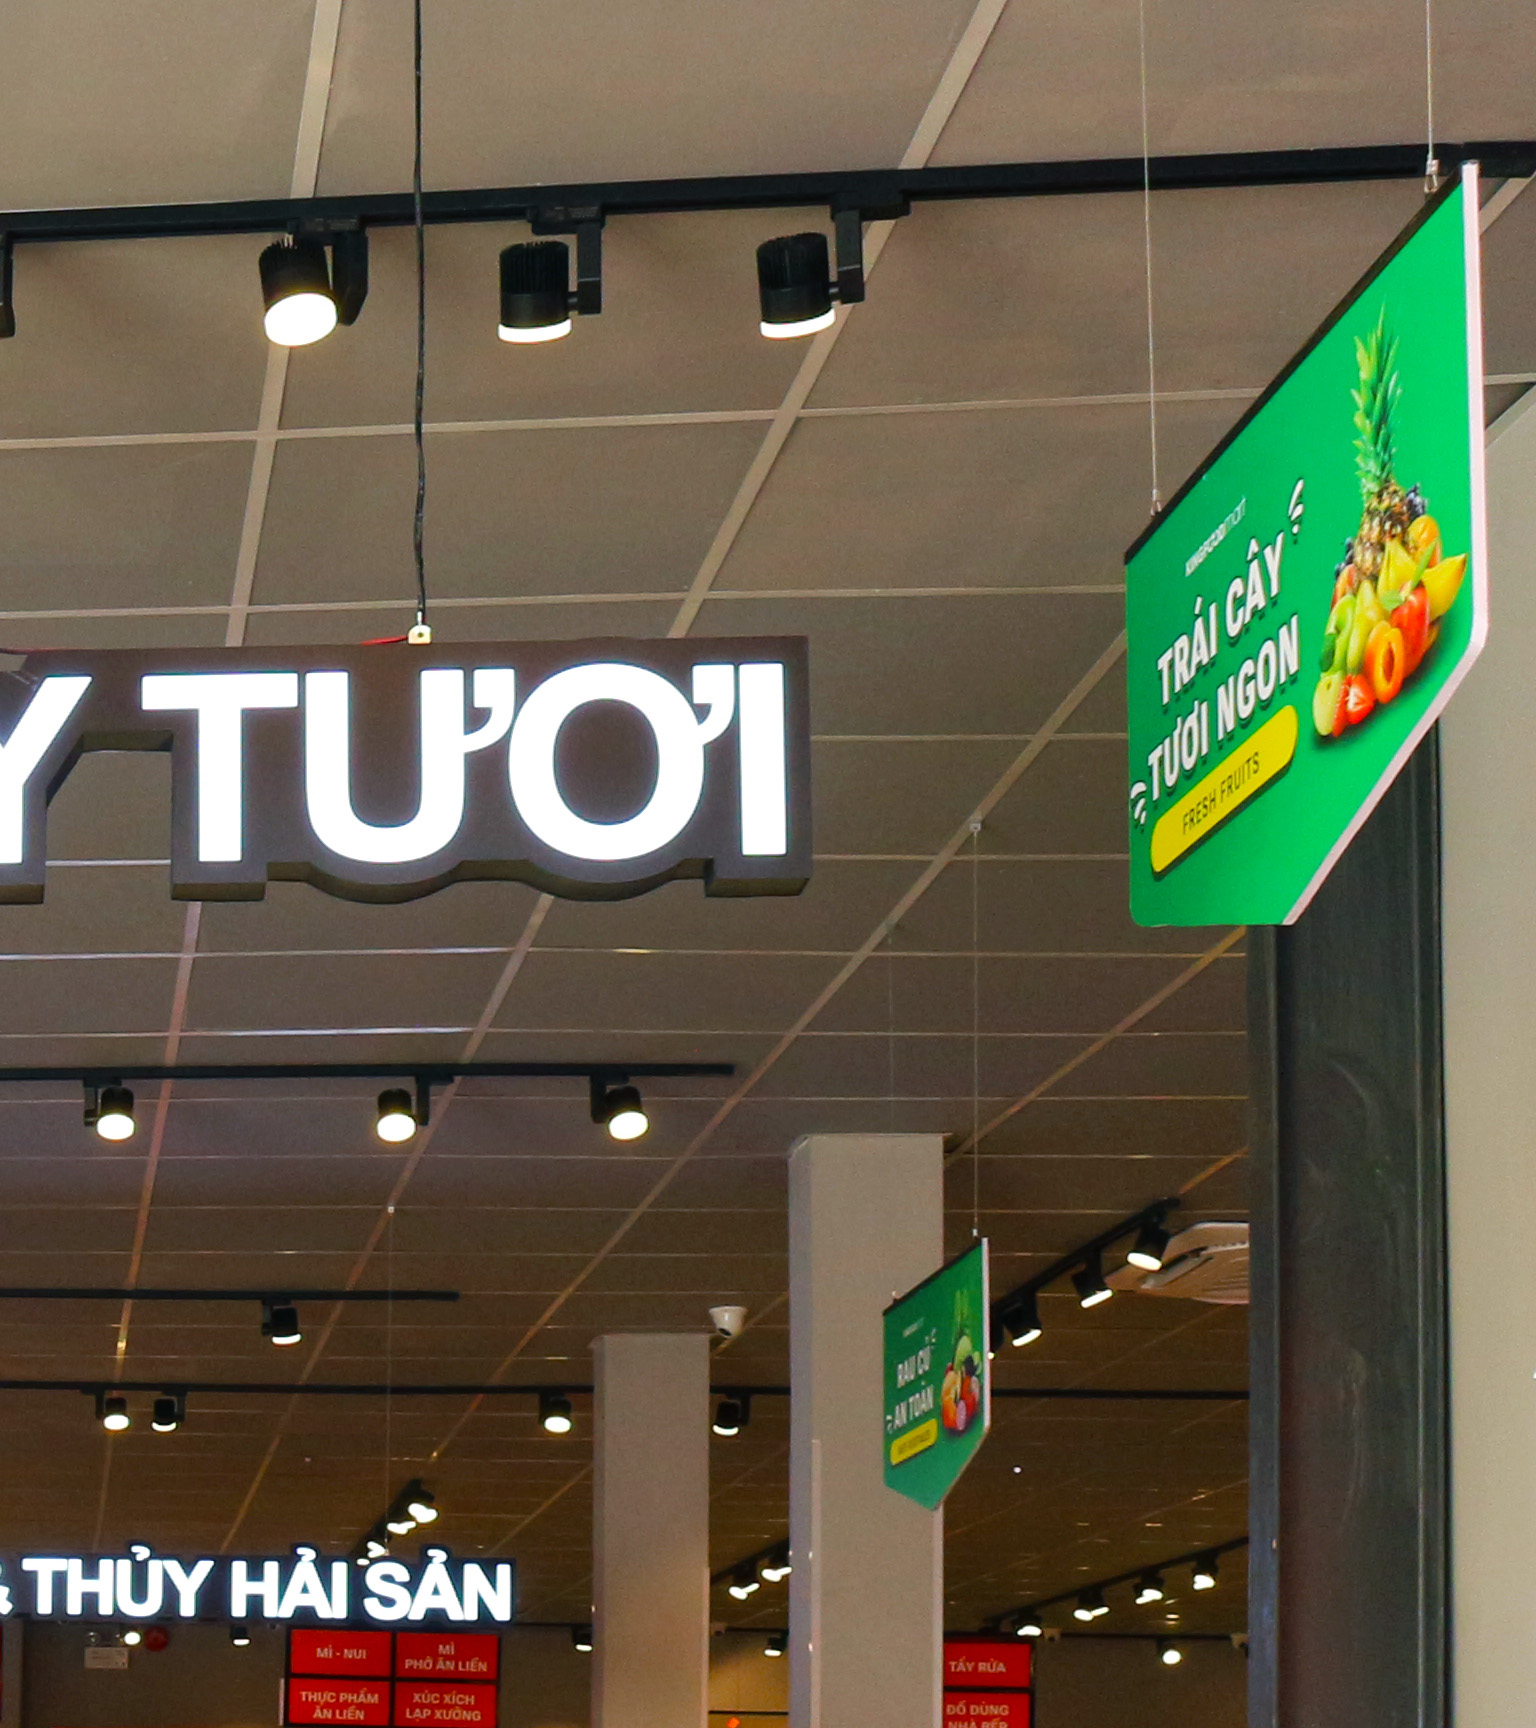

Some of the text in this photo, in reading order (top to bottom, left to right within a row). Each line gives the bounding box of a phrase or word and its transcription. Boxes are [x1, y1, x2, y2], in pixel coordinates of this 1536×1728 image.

[1157, 594, 1218, 706] TRÁI
[1226, 533, 1288, 640] CÂY
[1147, 614, 1300, 802] TƯƠI NGON
[143, 662, 786, 862] TƯƠI
[1182, 751, 1260, 836] FRESH FRUITS
[22, 1544, 216, 1618] THỦY
[230, 1547, 348, 1620] HẢI
[362, 1548, 513, 1623] SẢN
[343, 1648, 367, 1660] NUI
[300, 1690, 336, 1706] THỰC
